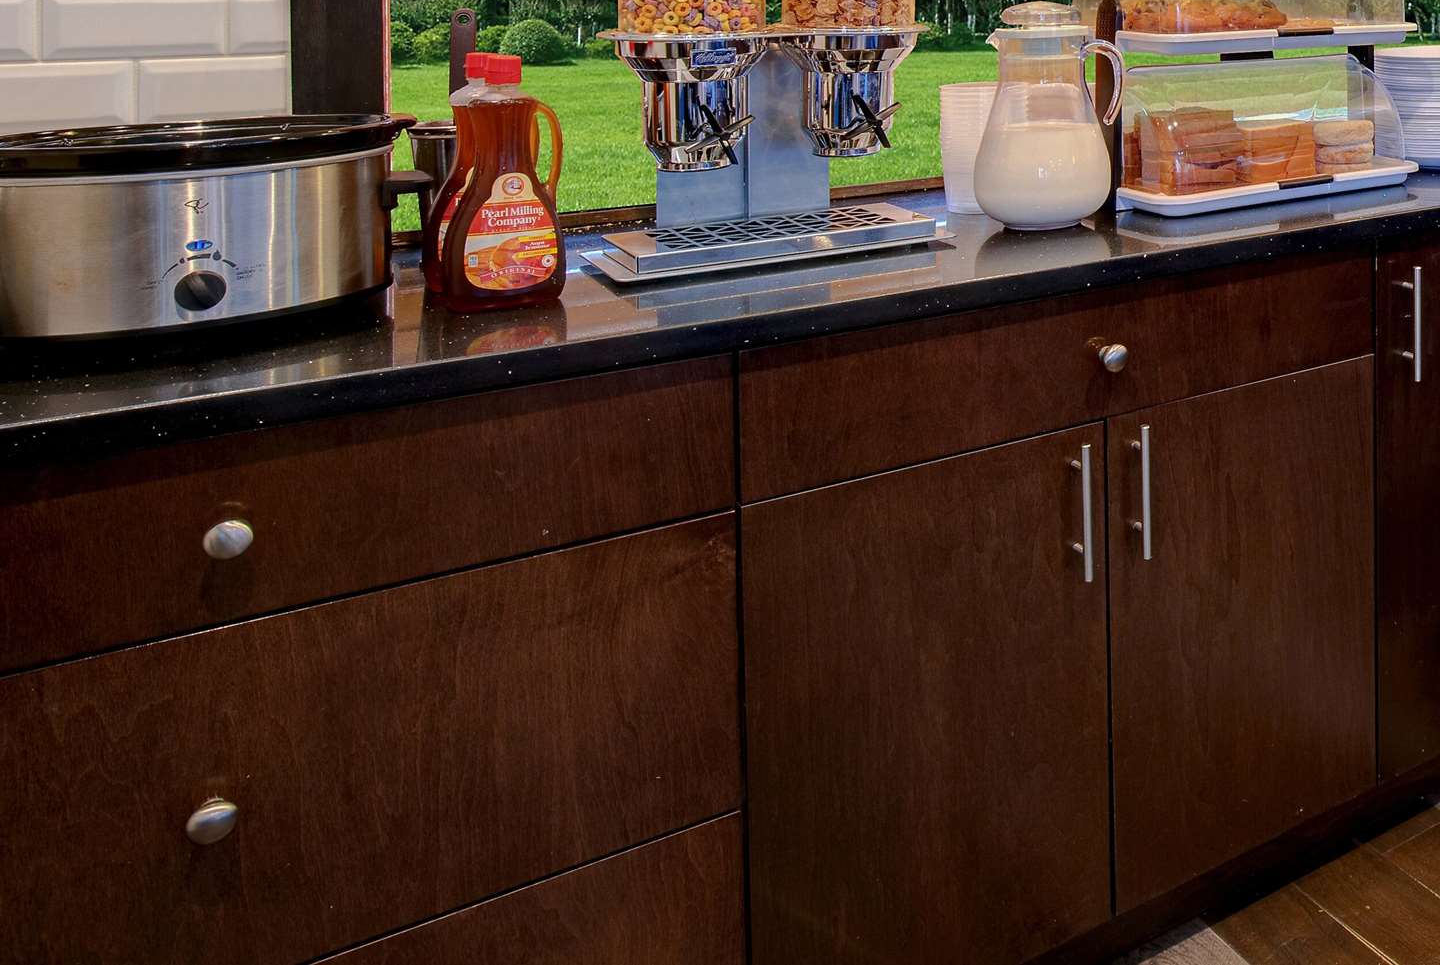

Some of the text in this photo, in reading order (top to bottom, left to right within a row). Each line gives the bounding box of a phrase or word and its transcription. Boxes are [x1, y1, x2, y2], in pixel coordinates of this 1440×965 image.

[481, 205, 545, 219] Pearl Milling
[487, 216, 537, 227] Company
